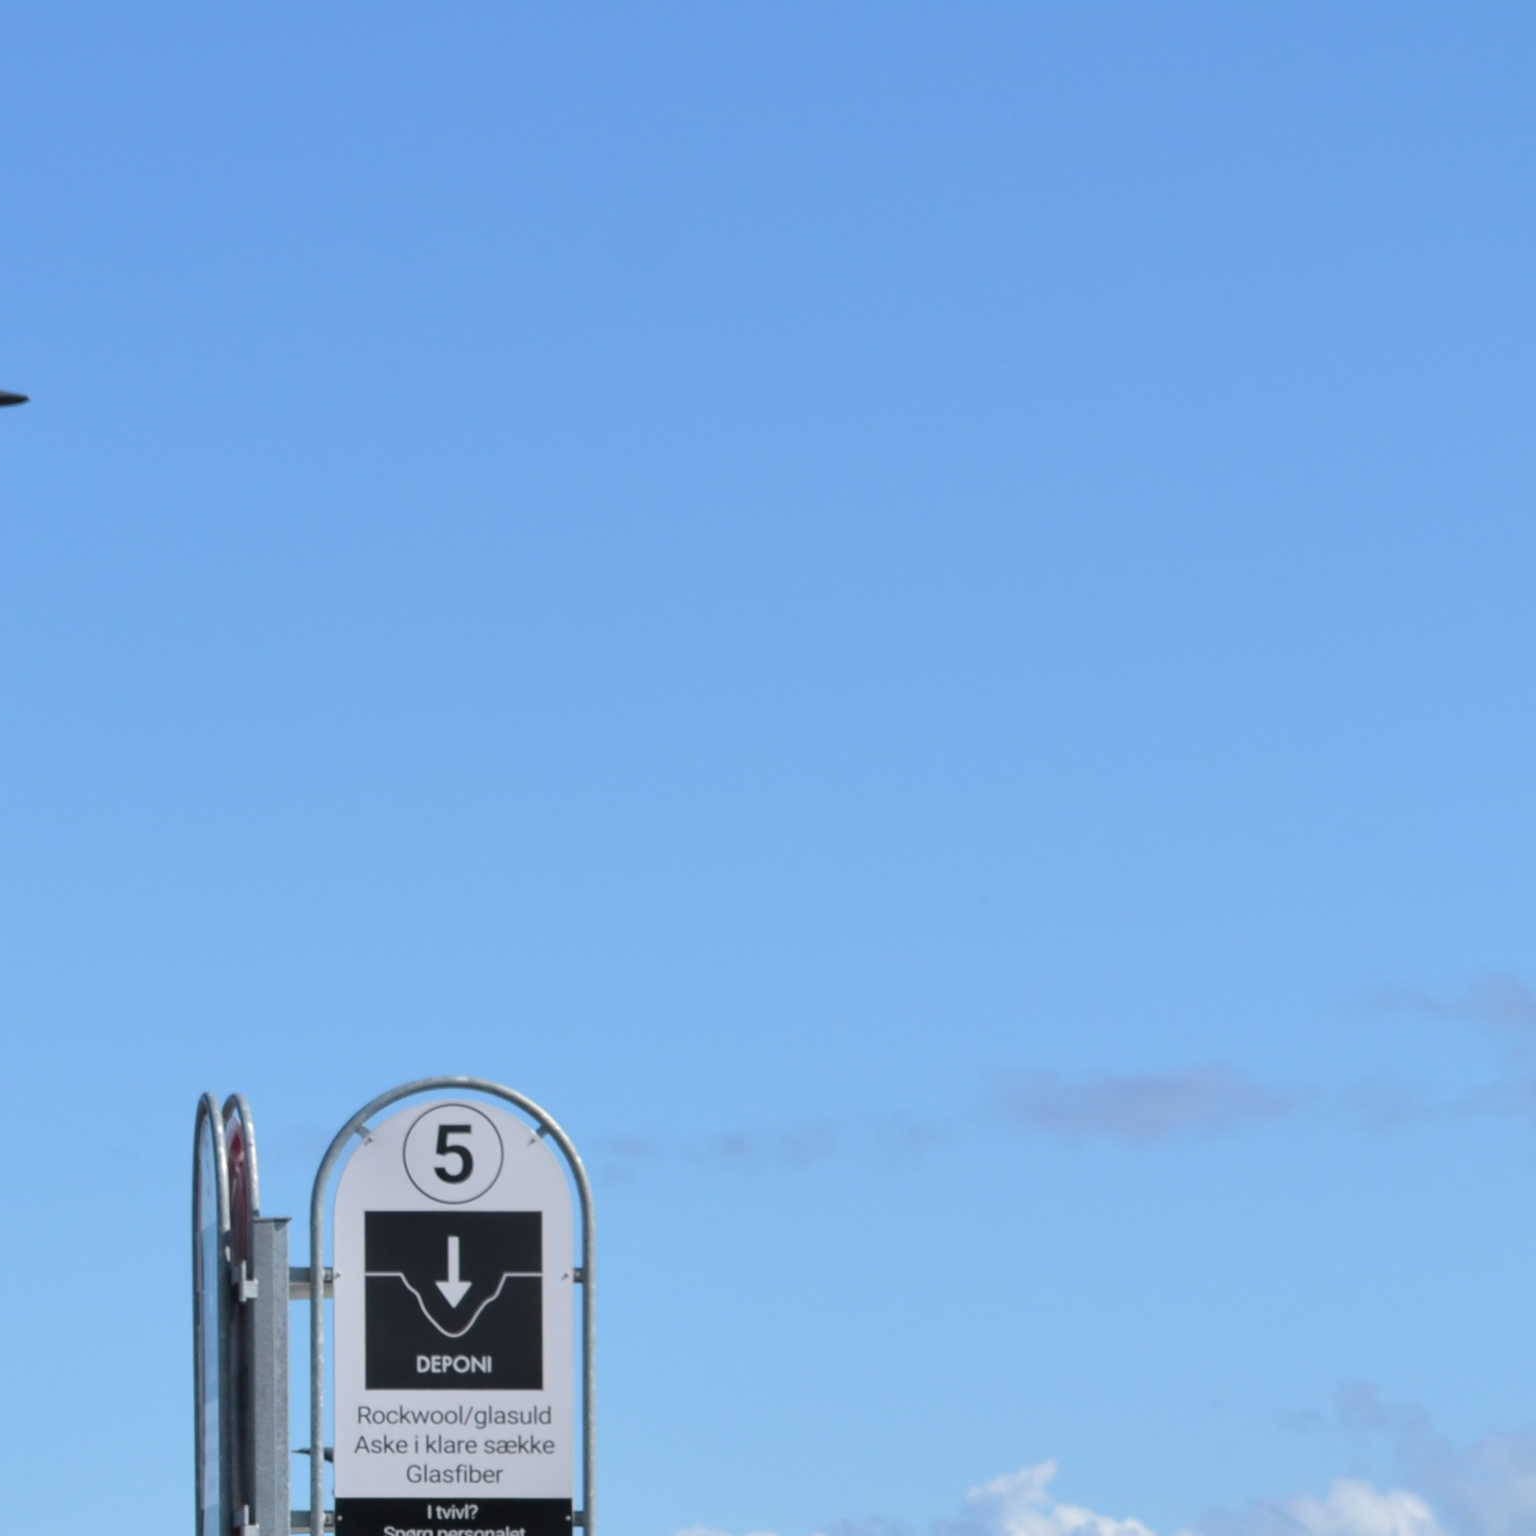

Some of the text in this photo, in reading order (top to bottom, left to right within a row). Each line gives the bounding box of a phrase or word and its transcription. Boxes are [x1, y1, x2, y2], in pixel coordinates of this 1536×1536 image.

[434, 1124, 473, 1184] 5
[416, 1356, 492, 1373] DEPONI
[357, 1405, 552, 1428] Rockwool/glasuld
[354, 1436, 408, 1455] Aske
[426, 1435, 477, 1455] klare
[484, 1435, 554, 1455] sække
[406, 1464, 503, 1484] Glasfiber
[427, 1504, 478, 1520] I tvivl?
